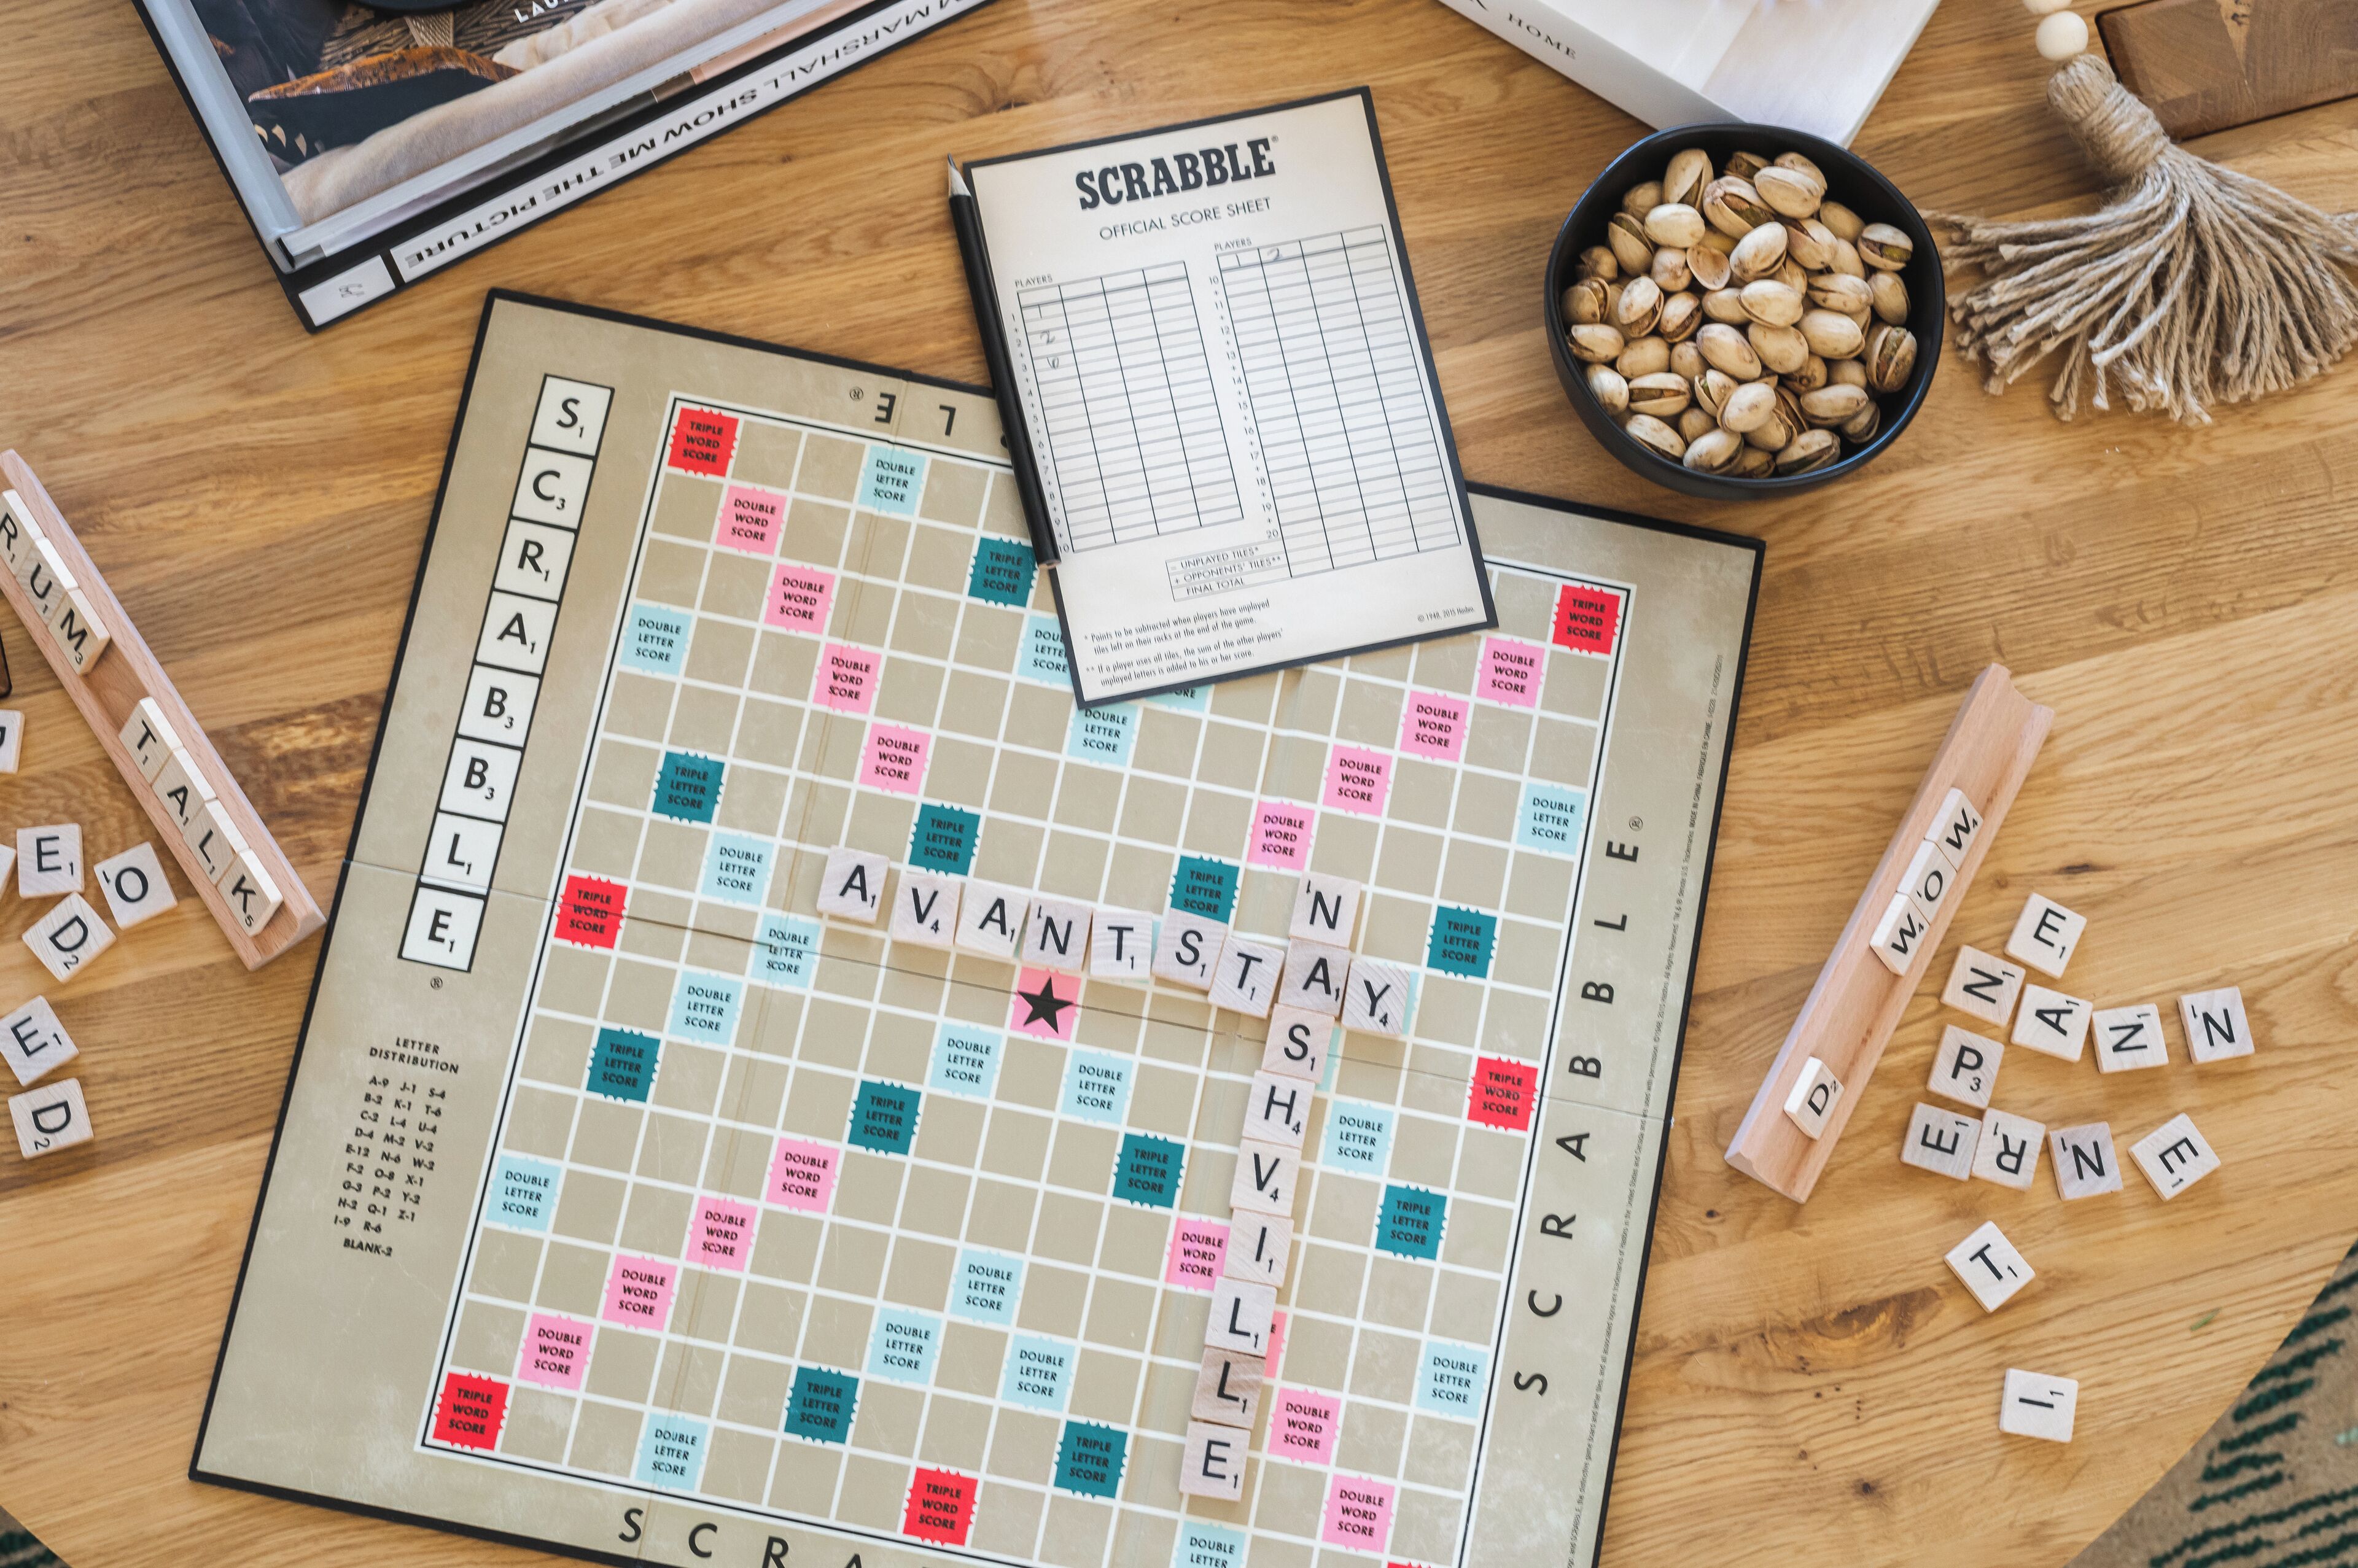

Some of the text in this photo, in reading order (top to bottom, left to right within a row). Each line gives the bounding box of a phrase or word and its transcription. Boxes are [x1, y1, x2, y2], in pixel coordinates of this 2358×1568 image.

[1508, 12, 1576, 60] HOME
[404, 7, 930, 269] MARSHALL SHOW ME THE PICTURE
[1099, 196, 1270, 241] OFFICIAL SCORE SHEET
[1214, 237, 1252, 252] PLAYERS
[1267, 247, 1283, 262] 2
[1014, 274, 1053, 289] PLAYERS
[1208, 275, 1219, 286] 10
[689, 420, 725, 437] TRIPLE
[685, 433, 721, 449] WORD
[681, 448, 718, 464] SCORE
[1266, 528, 1279, 539] 20
[1180, 554, 1229, 568] UNPLAYED
[1183, 564, 1245, 581] OPPONENTS'
[781, 576, 825, 594] DOUBLE
[1186, 577, 1243, 595] FINAL TOTAL
[782, 591, 818, 607] WORD
[1571, 597, 1607, 615] TRIPLE
[779, 605, 815, 621] SCORE
[1090, 632, 1113, 642] Points
[1134, 619, 1170, 633] subtracted
[1172, 617, 1191, 626] when
[1193, 612, 1218, 624] players
[1218, 608, 1236, 616] have
[1238, 599, 1270, 613] unplayed
[1568, 611, 1605, 627] WORD
[1093, 645, 1109, 654] tiles
[1110, 642, 1123, 651] left
[1135, 638, 1151, 646] their
[1153, 632, 1172, 643] racks
[1183, 628, 1195, 637] the
[1196, 623, 1210, 634] end
[1211, 622, 1219, 631] of
[1220, 621, 1232, 629] the
[1234, 618, 1256, 628] game.
[1566, 624, 1603, 642] SCORE
[1097, 665, 1103, 673] If
[1111, 661, 1134, 672] player
[1153, 653, 1162, 662] all
[1164, 651, 1181, 660] tiles,
[1183, 648, 1195, 656] the
[1213, 641, 1221, 650] of
[1222, 640, 1234, 648] the
[1236, 636, 1255, 645] other
[1256, 627, 1284, 643] players'
[1100, 672, 1132, 686] unplayed
[1133, 670, 1156, 680] letters
[1165, 661, 1188, 673] added
[1197, 658, 1209, 667] his
[1219, 653, 1231, 662] her
[1263, 813, 1305, 830] DOUBLE
[1264, 828, 1299, 843] WORD
[718, 845, 762, 864] DOUBLE
[1261, 843, 1296, 858] SCORE
[718, 861, 757, 878] LETTER
[717, 876, 752, 892] SCORE
[1446, 919, 1483, 937] TRIPLE
[1442, 934, 1481, 952] LETTER
[1440, 948, 1478, 966] SCORE
[395, 1037, 440, 1055] LETTER
[369, 1047, 459, 1074] DISTRIBUTION
[1078, 1064, 1122, 1082] DOUBLE
[1487, 1070, 1523, 1087] TRIPLE
[1078, 1079, 1116, 1096] LETTER
[1484, 1085, 1521, 1101] WORD
[870, 1095, 906, 1112] TRIPLE
[1076, 1095, 1112, 1111] SCORE
[1481, 1100, 1519, 1117] SCORE
[865, 1109, 904, 1128] LETTER
[862, 1124, 901, 1142] SCORE
[784, 1151, 829, 1170] DOUBLE
[785, 1166, 822, 1183] WORD
[780, 1181, 819, 1199] SCORE
[343, 1238, 393, 1257] BLANK-2
[885, 1322, 931, 1341] DOUBLE
[885, 1338, 924, 1356] LETTER
[882, 1354, 919, 1370] SCORE
[1432, 1356, 1479, 1374] DOUBLE
[1433, 1372, 1472, 1389] LETTER
[1431, 1388, 1468, 1404] SCORE
